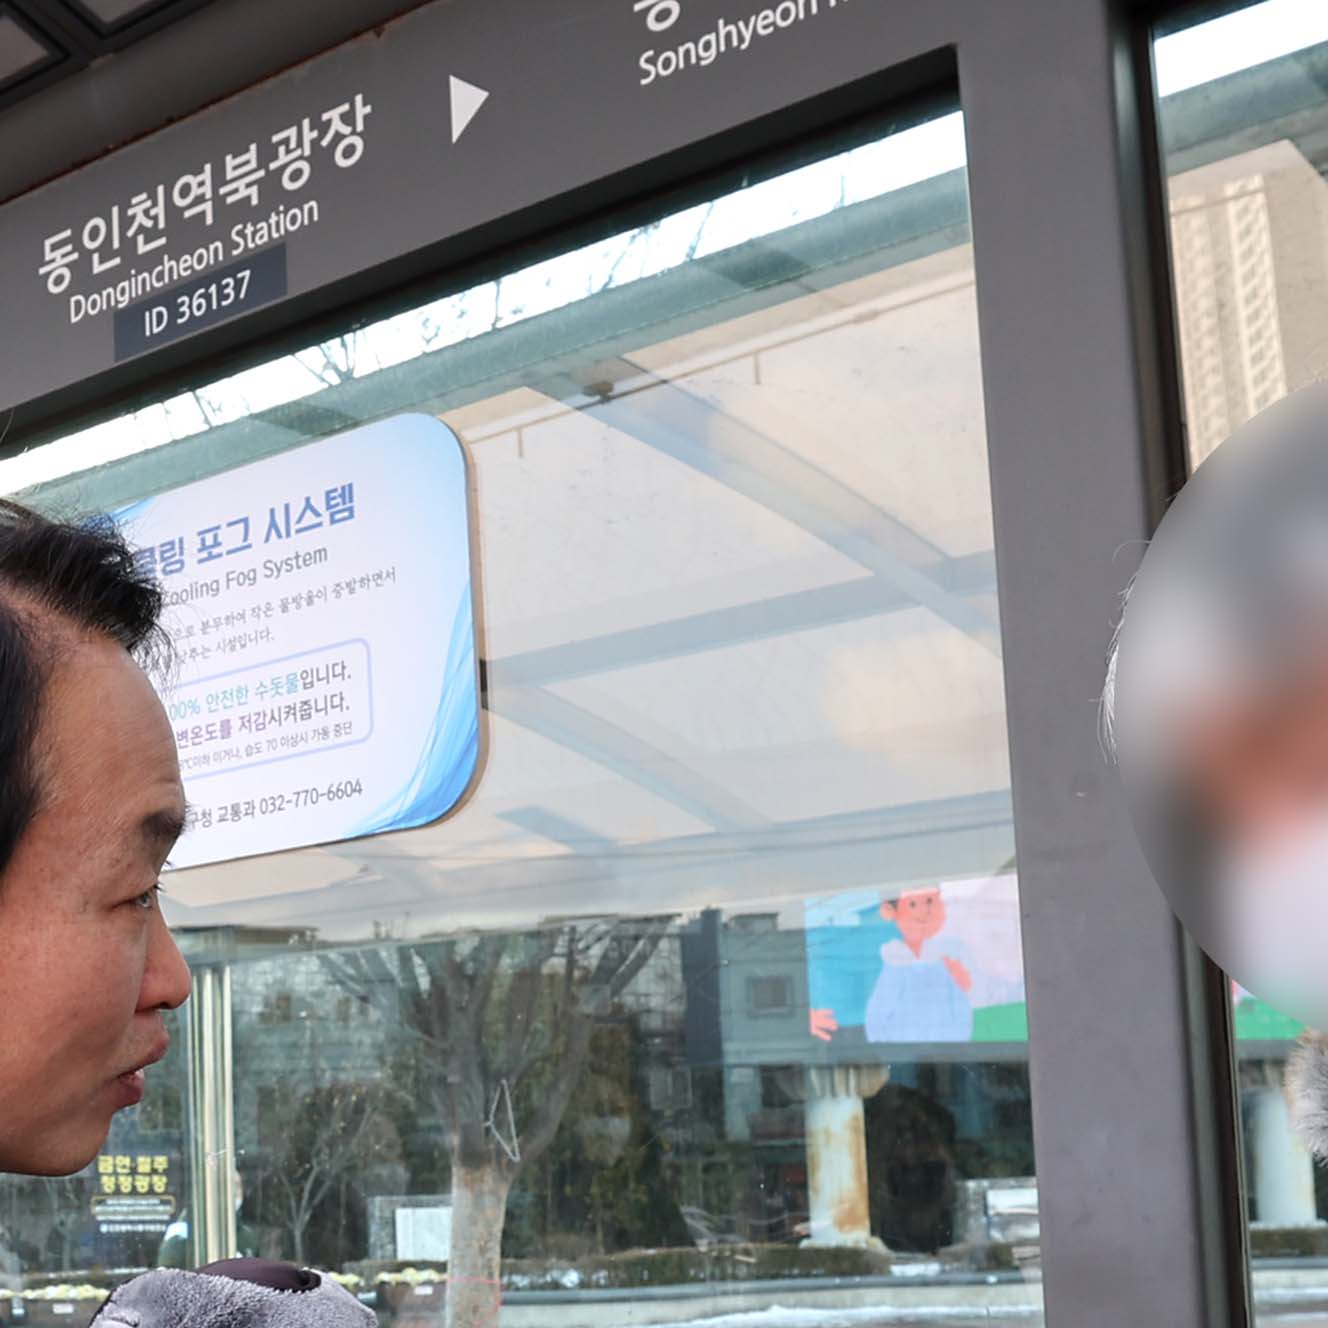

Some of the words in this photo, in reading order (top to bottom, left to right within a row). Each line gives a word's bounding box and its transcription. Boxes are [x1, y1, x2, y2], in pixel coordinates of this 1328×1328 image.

[38, 92, 373, 295] 동인천역북광장
[70, 240, 223, 324] Dongincheon
[230, 199, 320, 257] Station
[144, 306, 168, 337] ID
[175, 268, 253, 325] 36137
[196, 516, 253, 565] 포그
[263, 482, 356, 544] 시스템
[225, 566, 258, 592] Fog
[262, 546, 329, 580] System
[250, 601, 275, 621] 작은
[278, 585, 329, 614] 물방울이
[331, 565, 397, 600] 증발하면서
[168, 698, 201, 722] 00%
[205, 684, 250, 714] 안전한
[254, 660, 353, 699] 수돗물입니다.
[176, 717, 233, 750] 변온도를
[237, 691, 351, 734] 저감시켜줍니다.
[187, 807, 213, 831] 구청
[216, 799, 257, 824] 교통과
[258, 777, 364, 816] 032-770-6604
